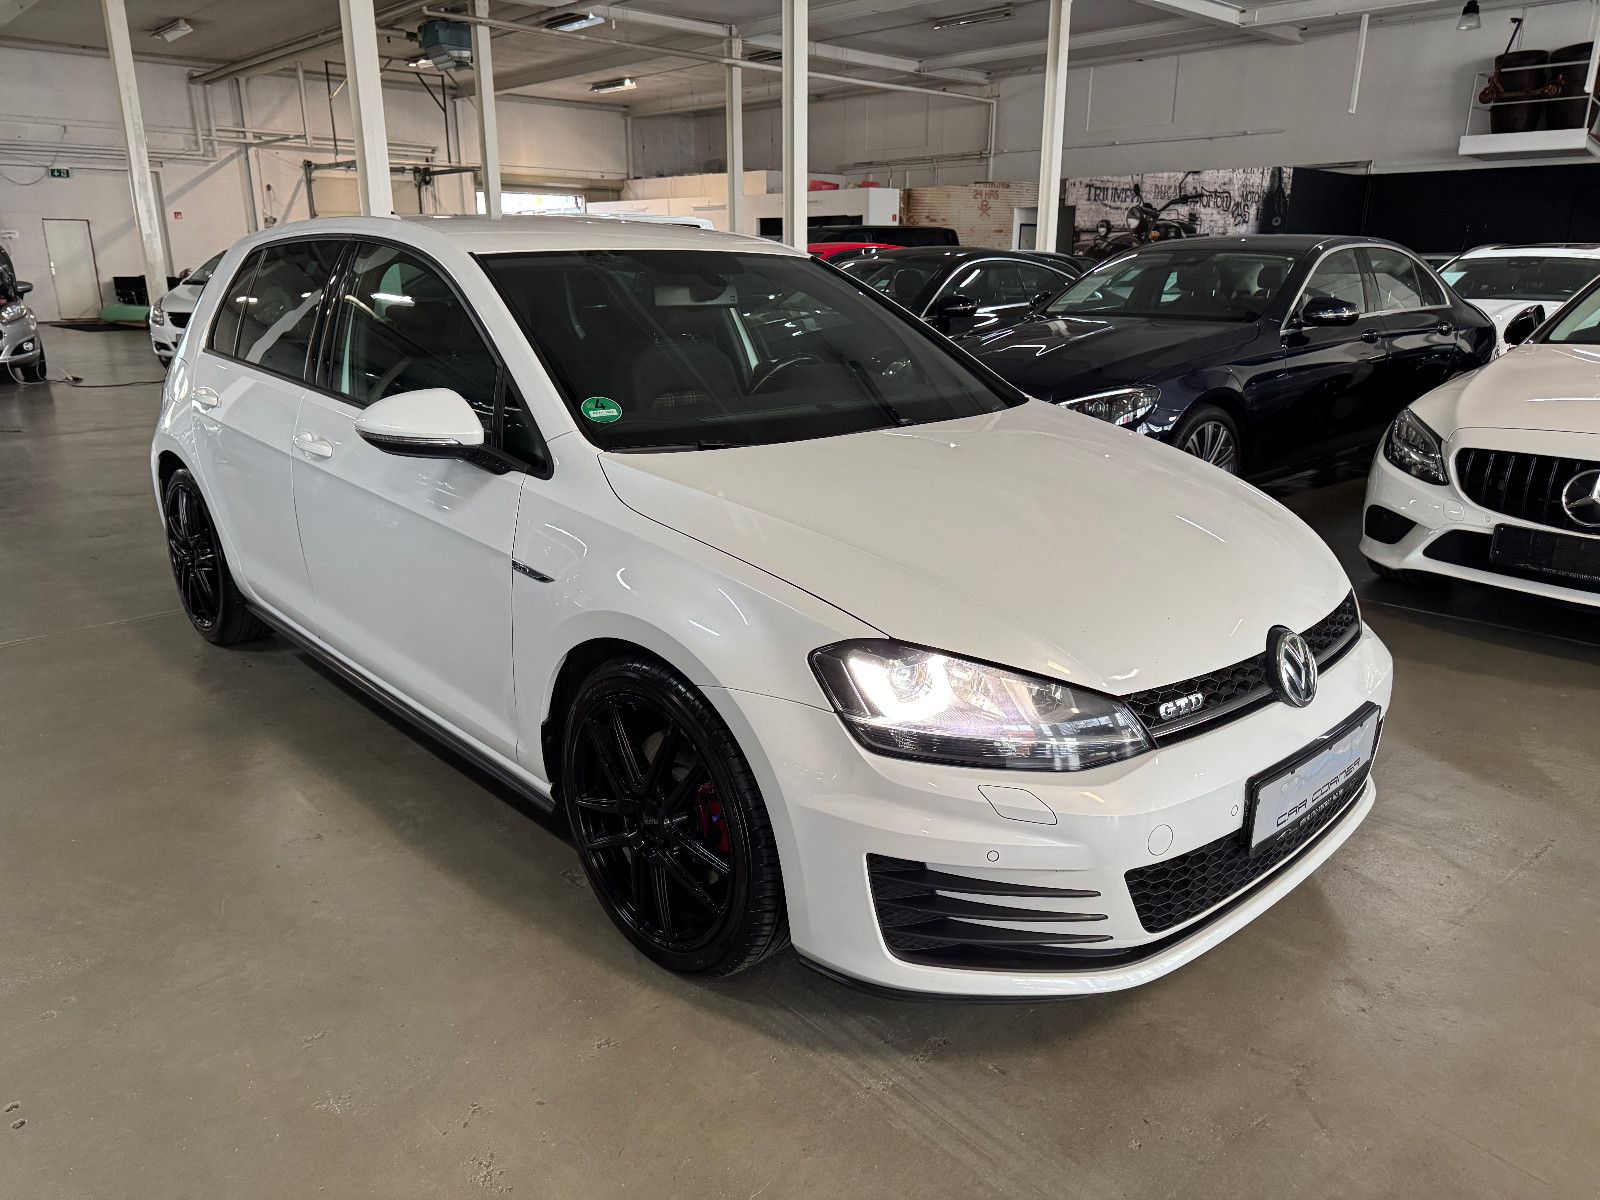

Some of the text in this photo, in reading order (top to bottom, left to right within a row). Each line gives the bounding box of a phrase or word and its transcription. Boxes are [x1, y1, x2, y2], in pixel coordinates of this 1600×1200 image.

[595, 399, 605, 410] 4
[1159, 692, 1204, 720] GTD
[1276, 798, 1308, 828] CAR
[1311, 756, 1361, 803] CORNER
